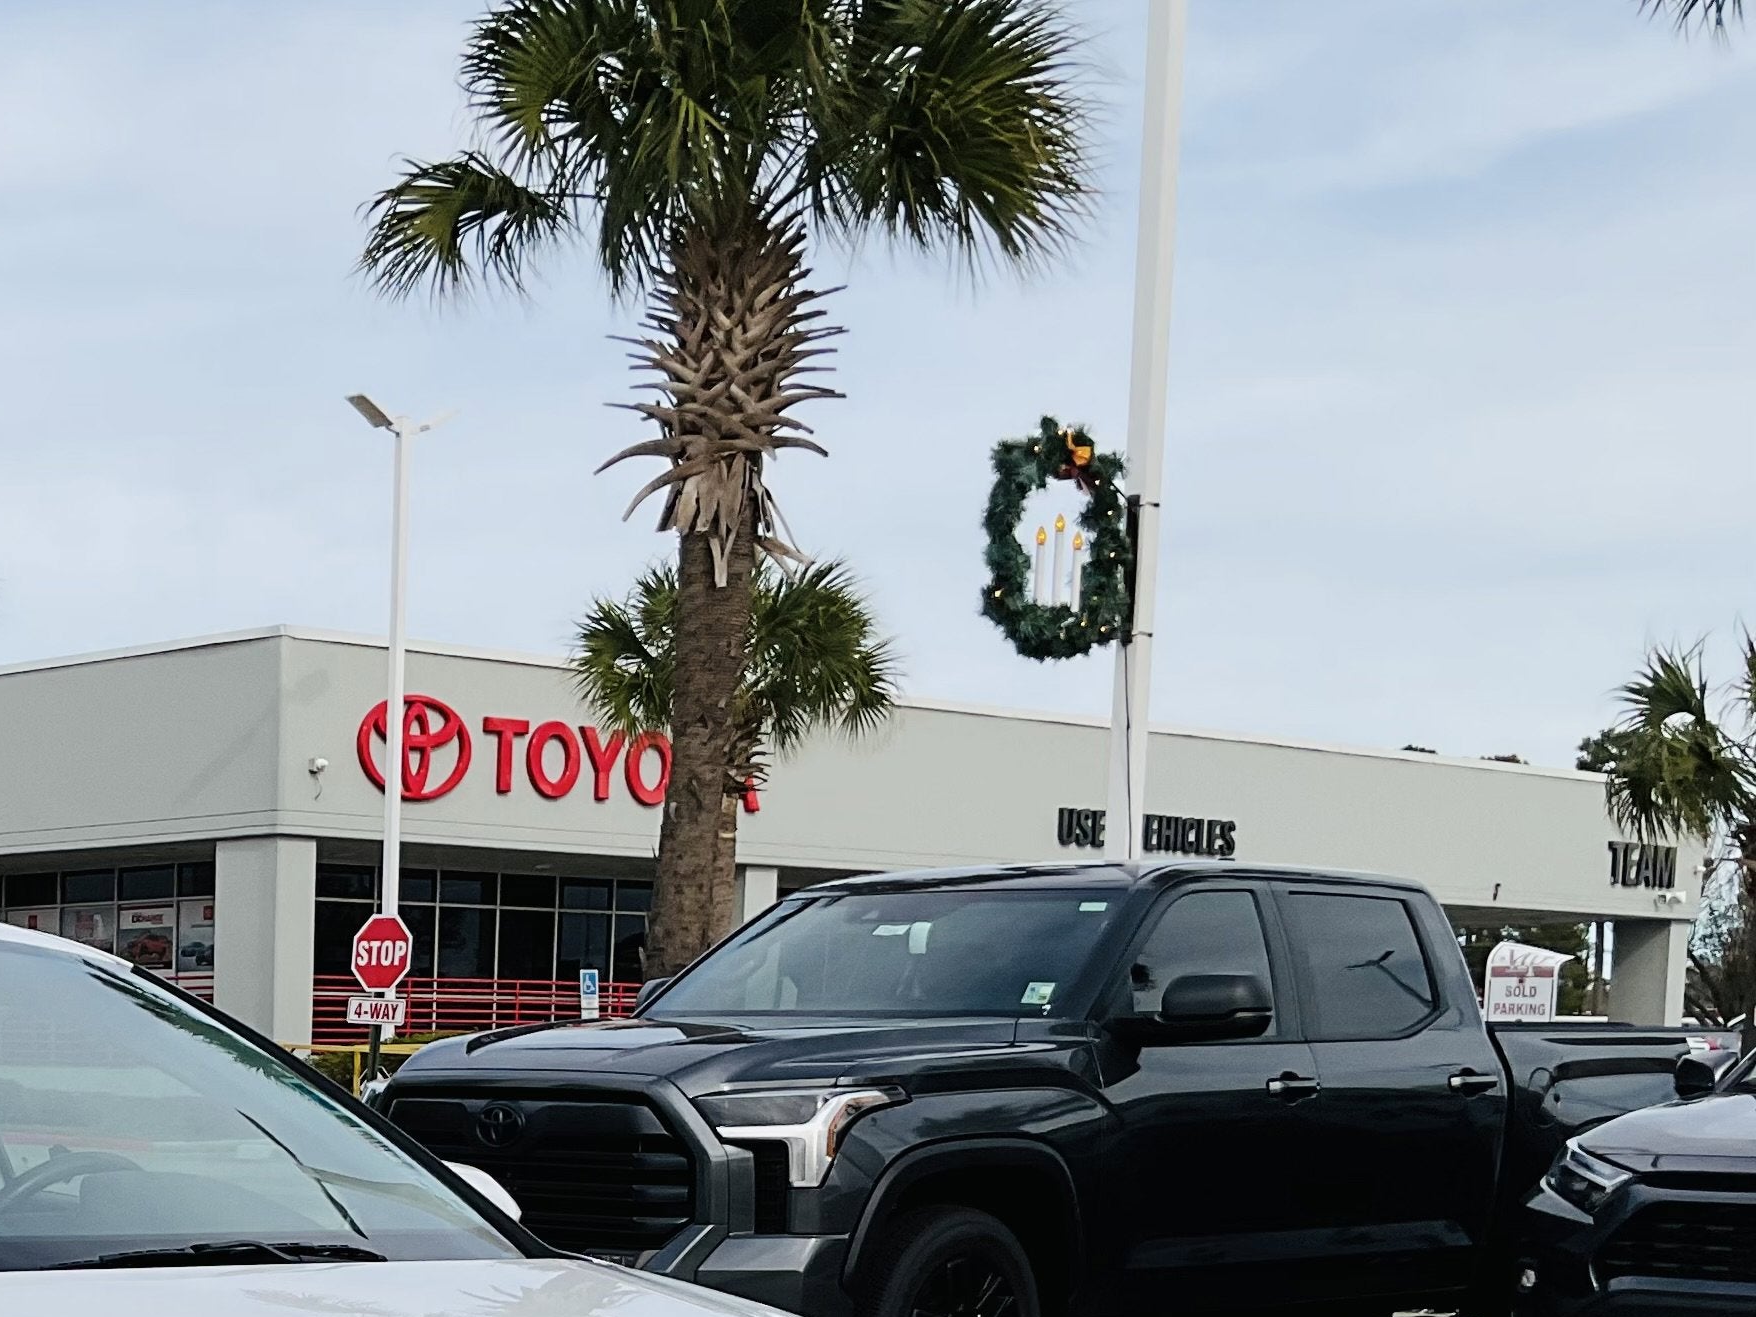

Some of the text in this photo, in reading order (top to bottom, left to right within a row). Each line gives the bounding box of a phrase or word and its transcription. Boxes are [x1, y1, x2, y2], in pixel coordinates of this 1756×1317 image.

[483, 716, 760, 813] TOYO
[1057, 807, 1236, 857] USE EHICLES
[1608, 840, 1678, 889] TEAM
[356, 940, 407, 967] STOP
[1505, 985, 1537, 998] SOLD
[354, 1002, 399, 1021] 4-WAY
[1493, 1003, 1546, 1016] PARKING
